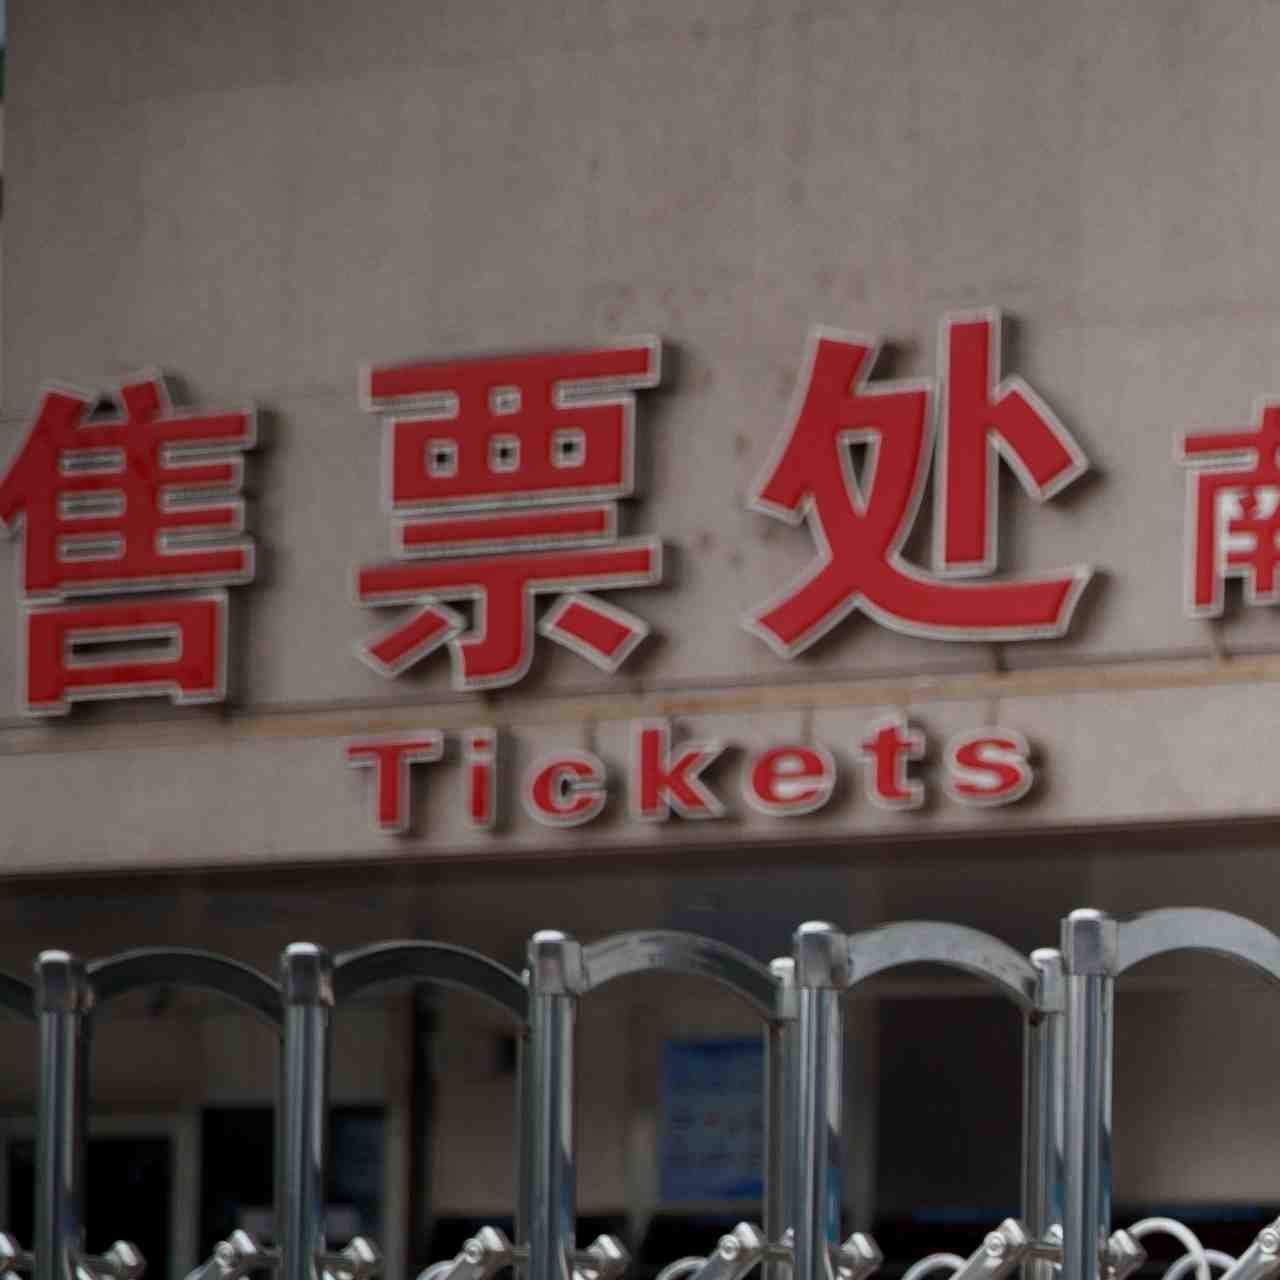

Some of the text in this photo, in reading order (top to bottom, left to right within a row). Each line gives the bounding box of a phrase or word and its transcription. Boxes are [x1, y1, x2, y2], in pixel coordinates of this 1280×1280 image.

[0, 308, 1090, 718] 售票处
[345, 716, 1034, 832] Tickets
